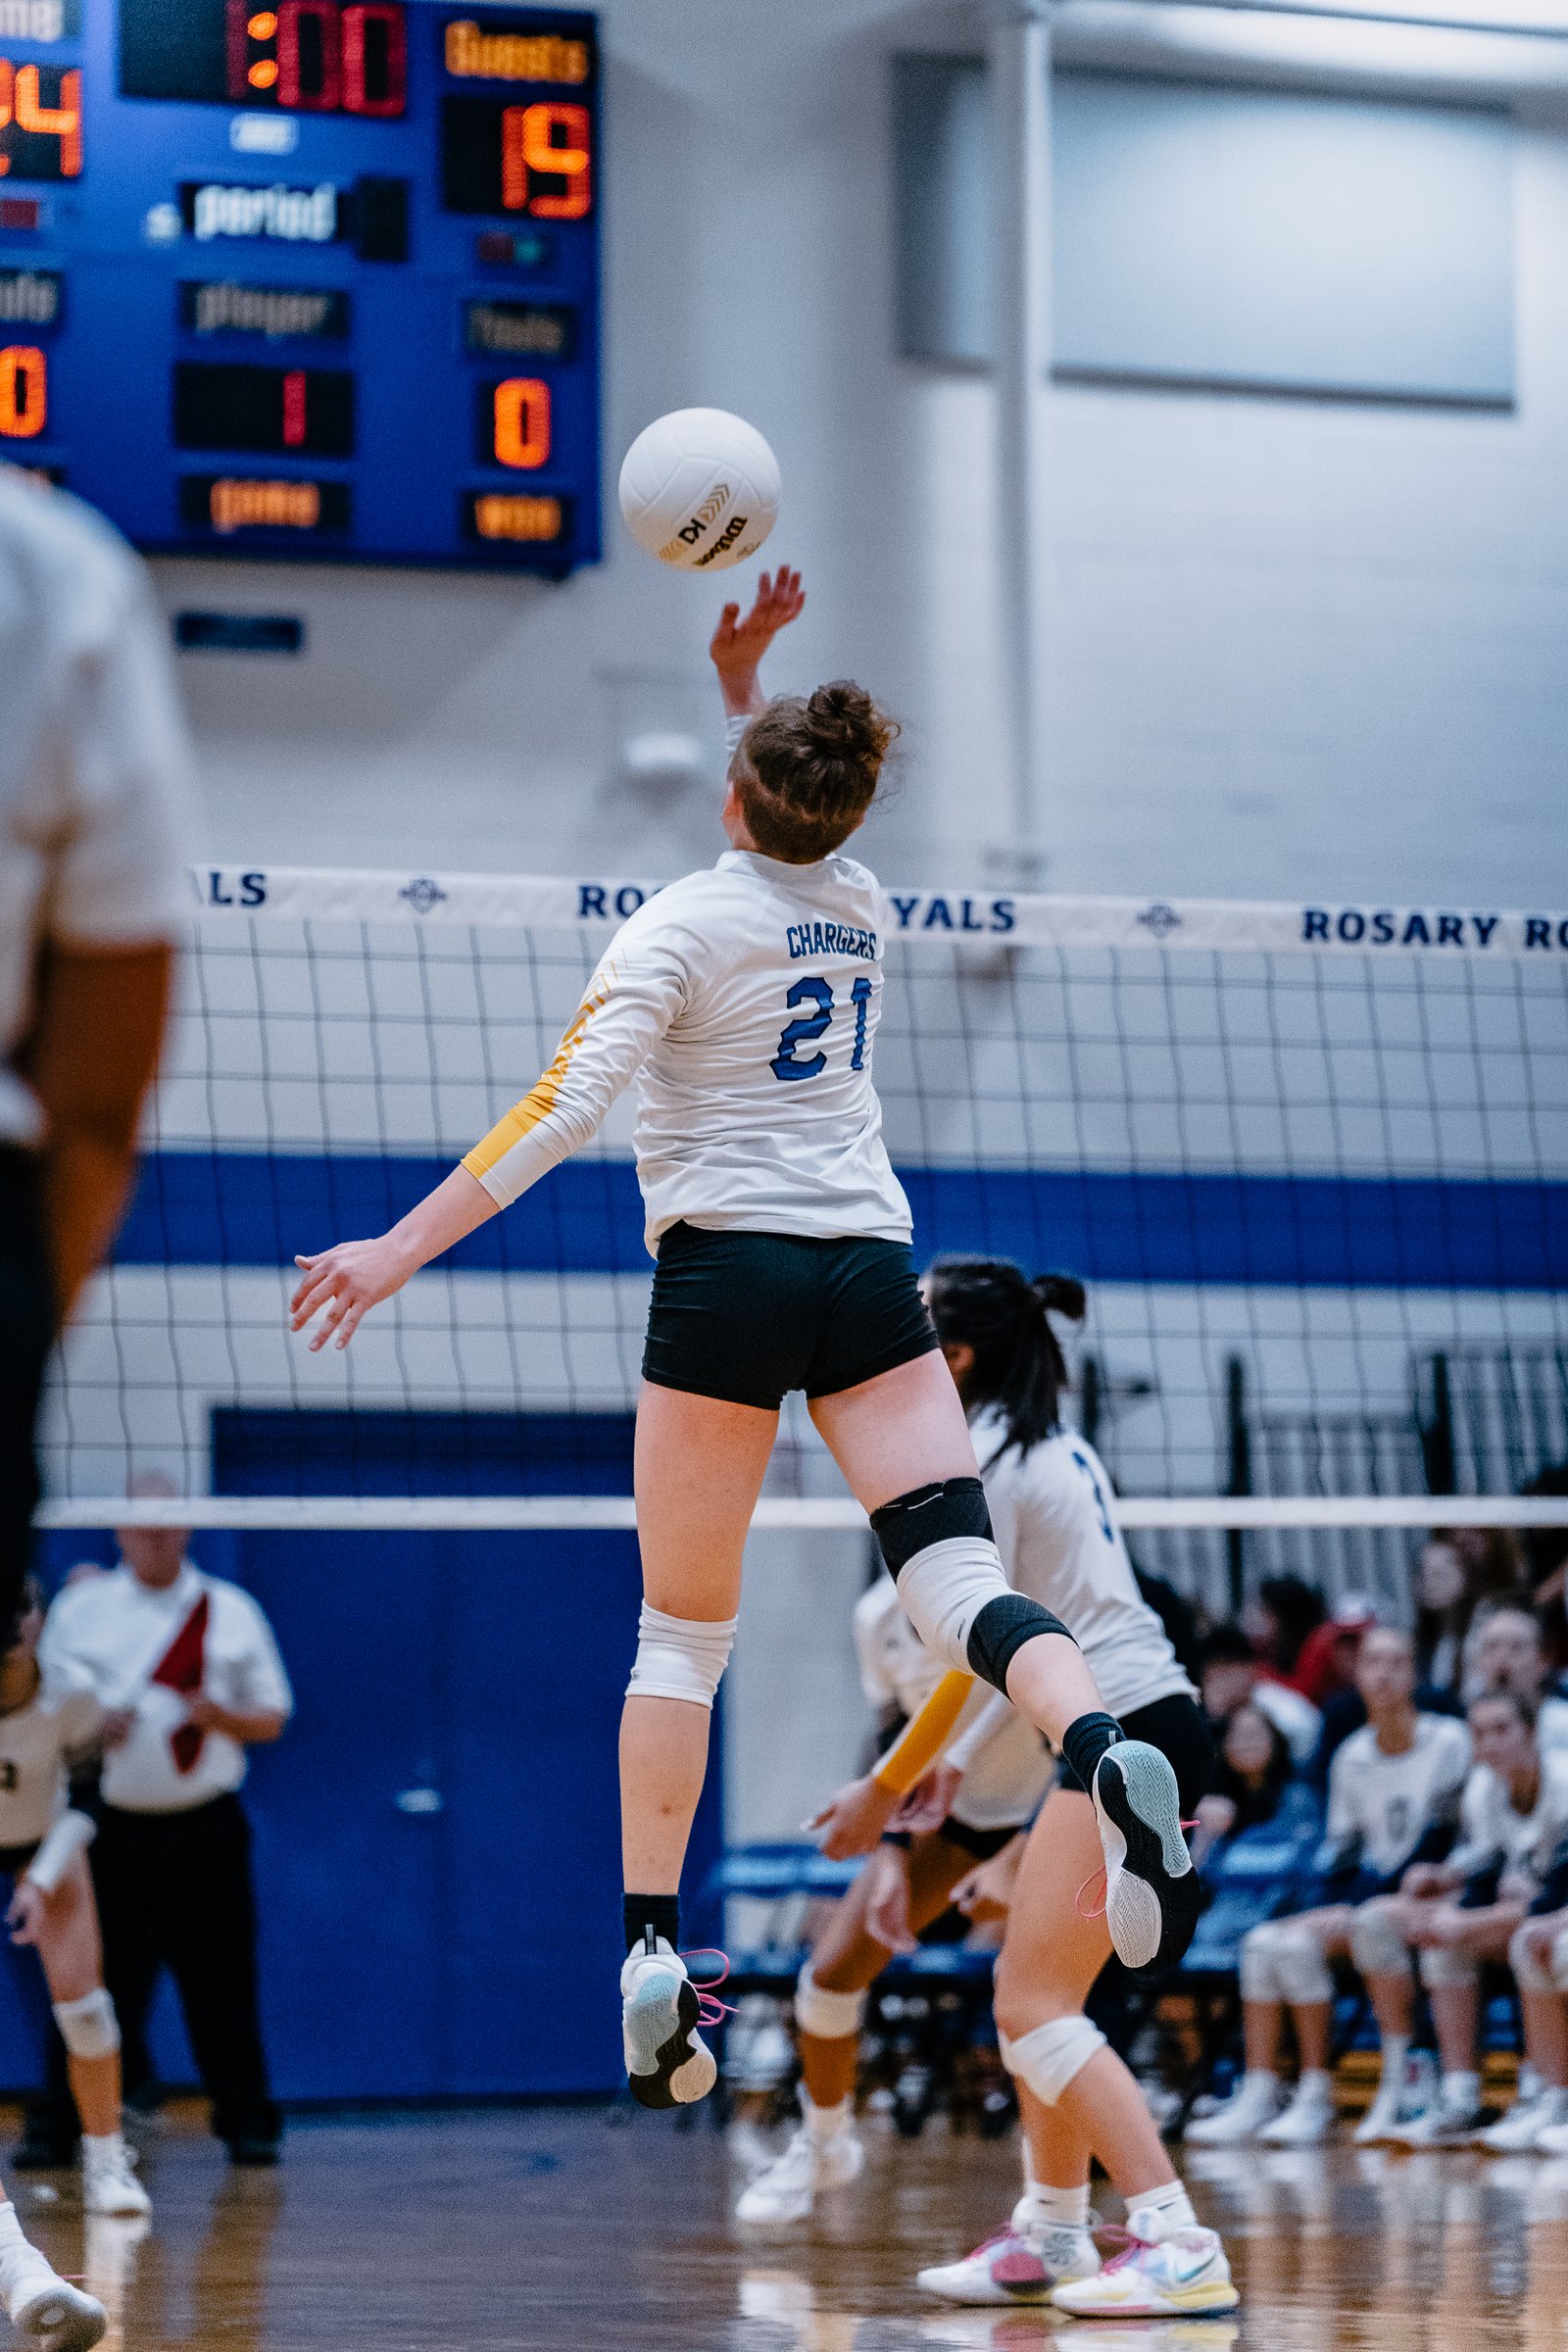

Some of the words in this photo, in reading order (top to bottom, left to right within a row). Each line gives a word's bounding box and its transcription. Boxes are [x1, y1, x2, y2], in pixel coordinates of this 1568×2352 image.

[502, 102, 590, 220] 19
[282, 370, 307, 446] 1
[494, 377, 551, 469] 0
[188, 870, 267, 907] LS
[576, 884, 666, 919] RO
[786, 922, 876, 961] CHARGERS
[1302, 909, 1499, 949] ROSARY
[769, 976, 872, 1081] 21
